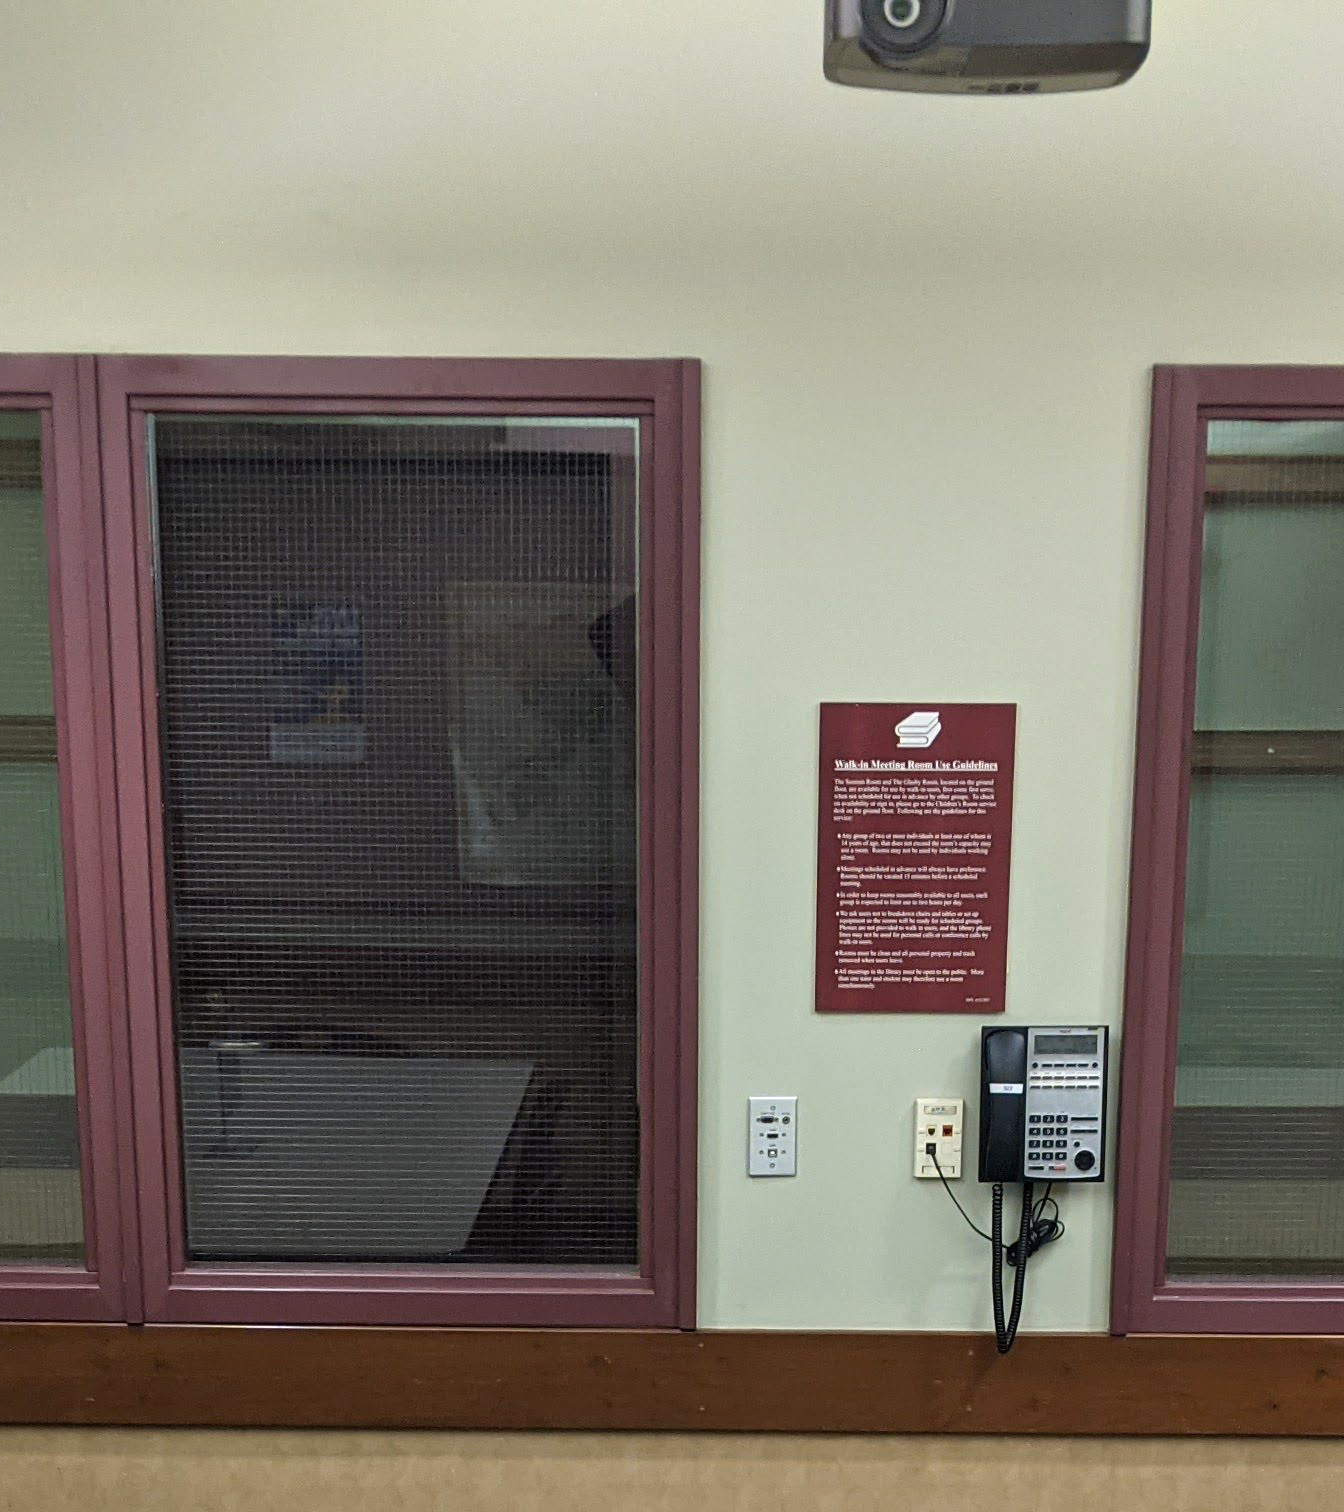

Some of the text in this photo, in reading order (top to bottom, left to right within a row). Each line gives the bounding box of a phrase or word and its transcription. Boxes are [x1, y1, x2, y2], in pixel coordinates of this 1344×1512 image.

[835, 760, 998, 771] Walk-in Meeting Room Use Guidelines
